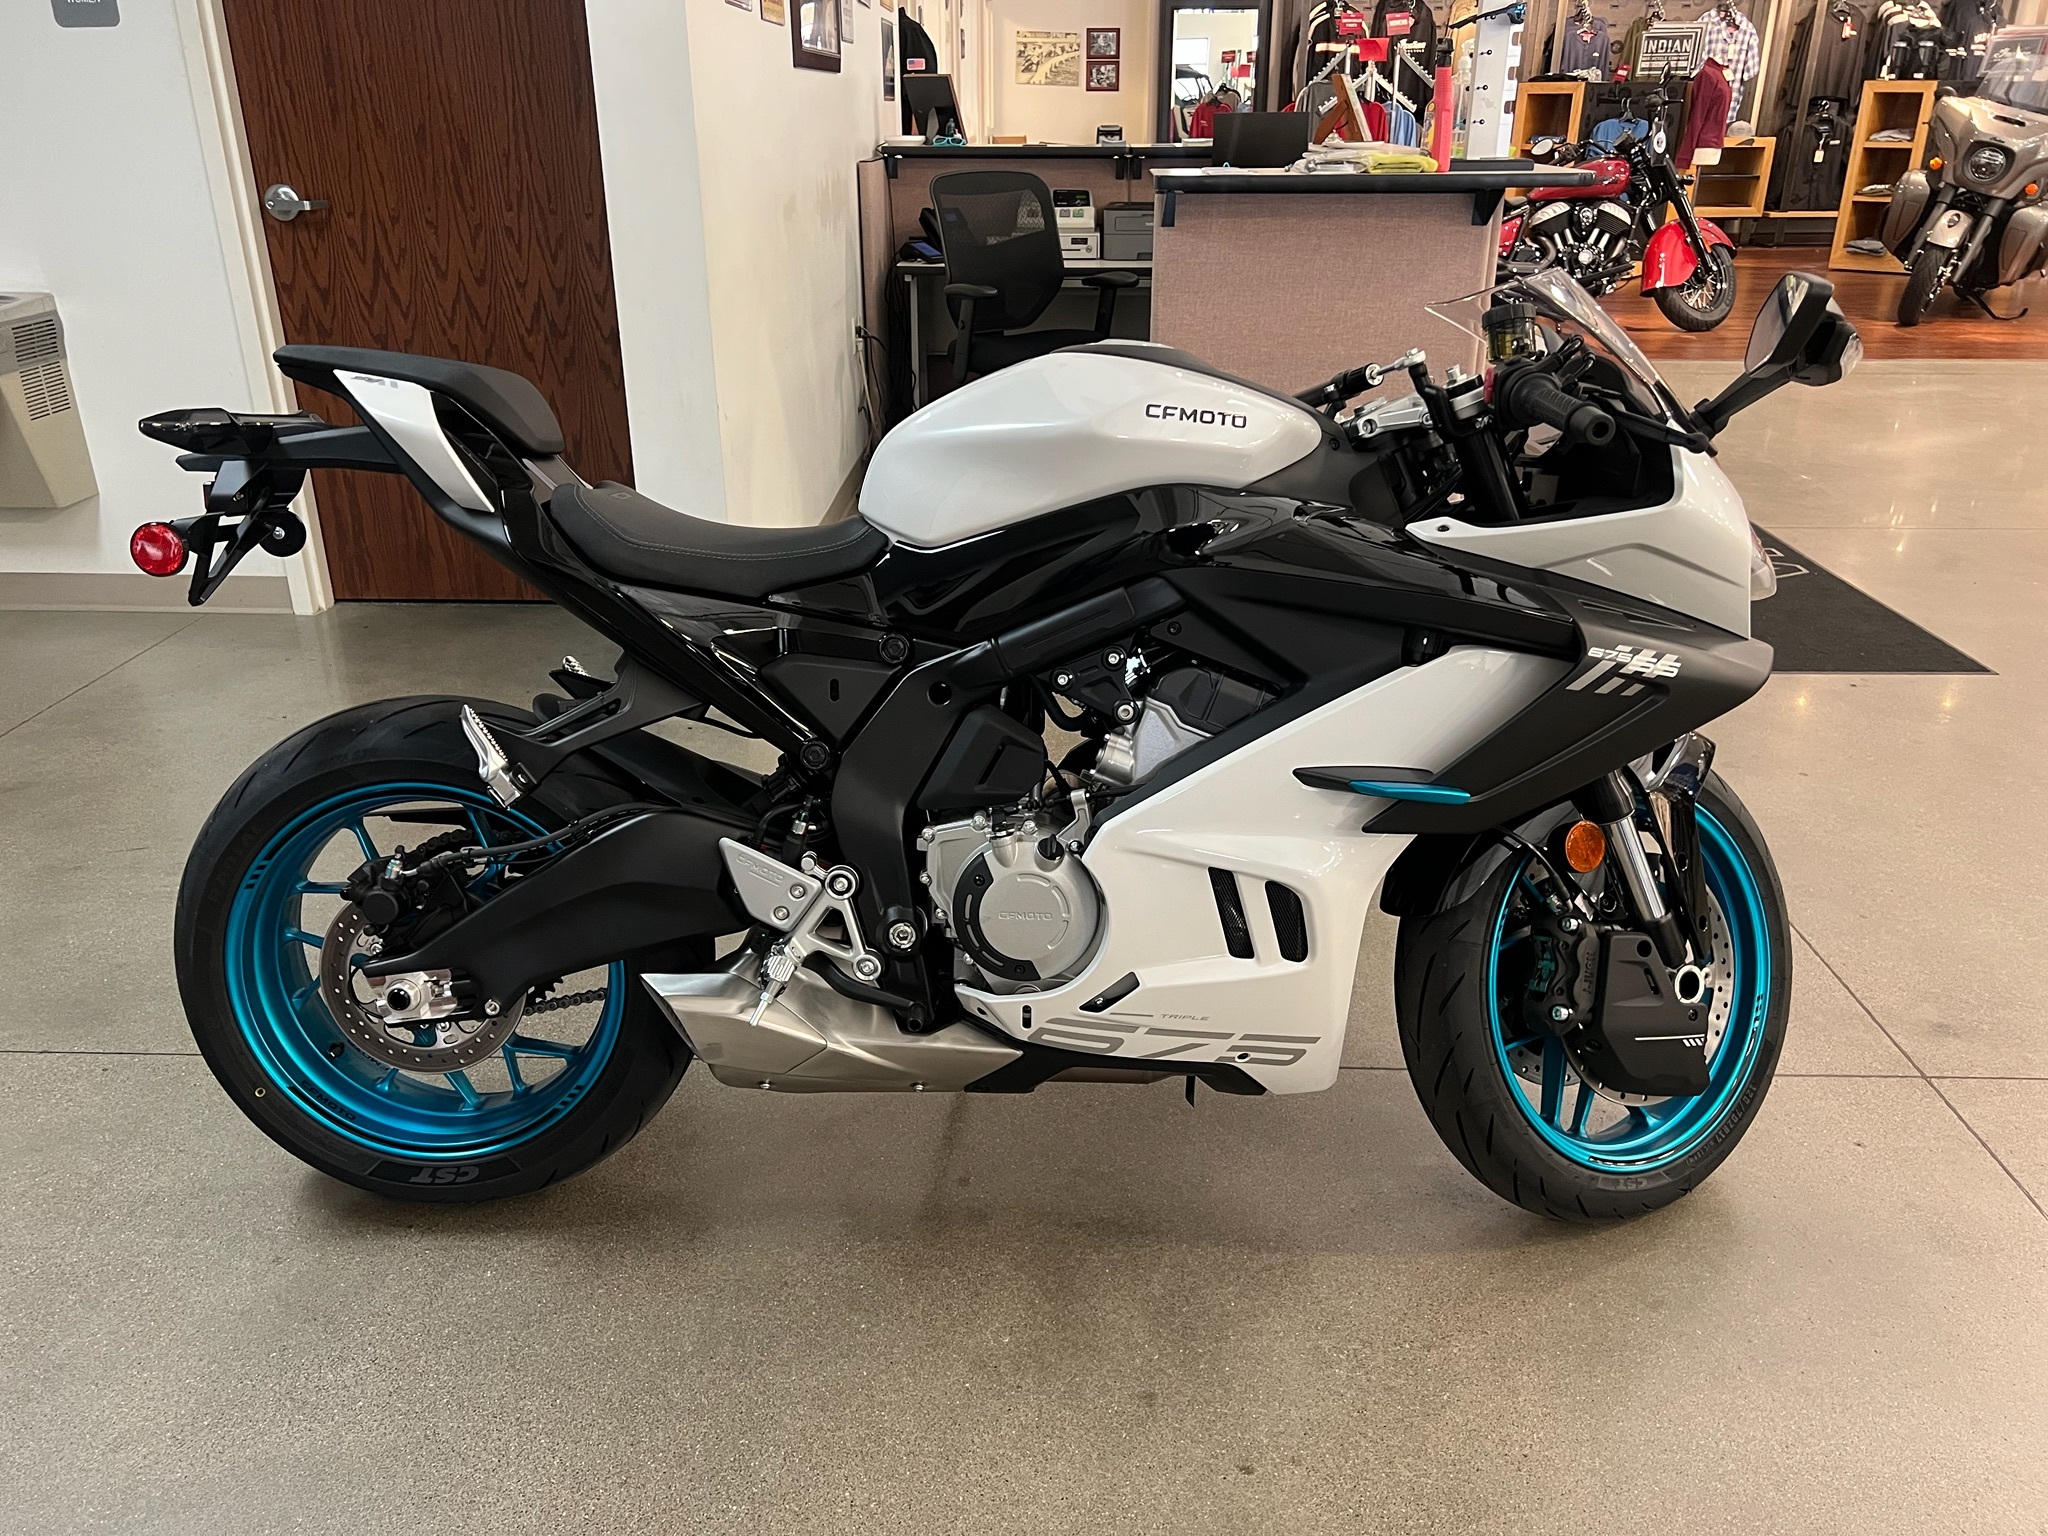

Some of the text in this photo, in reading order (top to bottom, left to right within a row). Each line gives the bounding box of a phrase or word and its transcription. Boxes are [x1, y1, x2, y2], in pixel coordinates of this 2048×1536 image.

[1643, 38, 1692, 53] INDIAN
[1145, 403, 1248, 429] CFMOTO
[735, 852, 784, 883] CFMOTO
[998, 910, 1054, 921] CFMOTO
[1161, 1013, 1211, 1022] TRIPLE
[1027, 1017, 1322, 1067] 675
[301, 1079, 357, 1121] CFMOTO
[409, 1165, 480, 1184] CST
